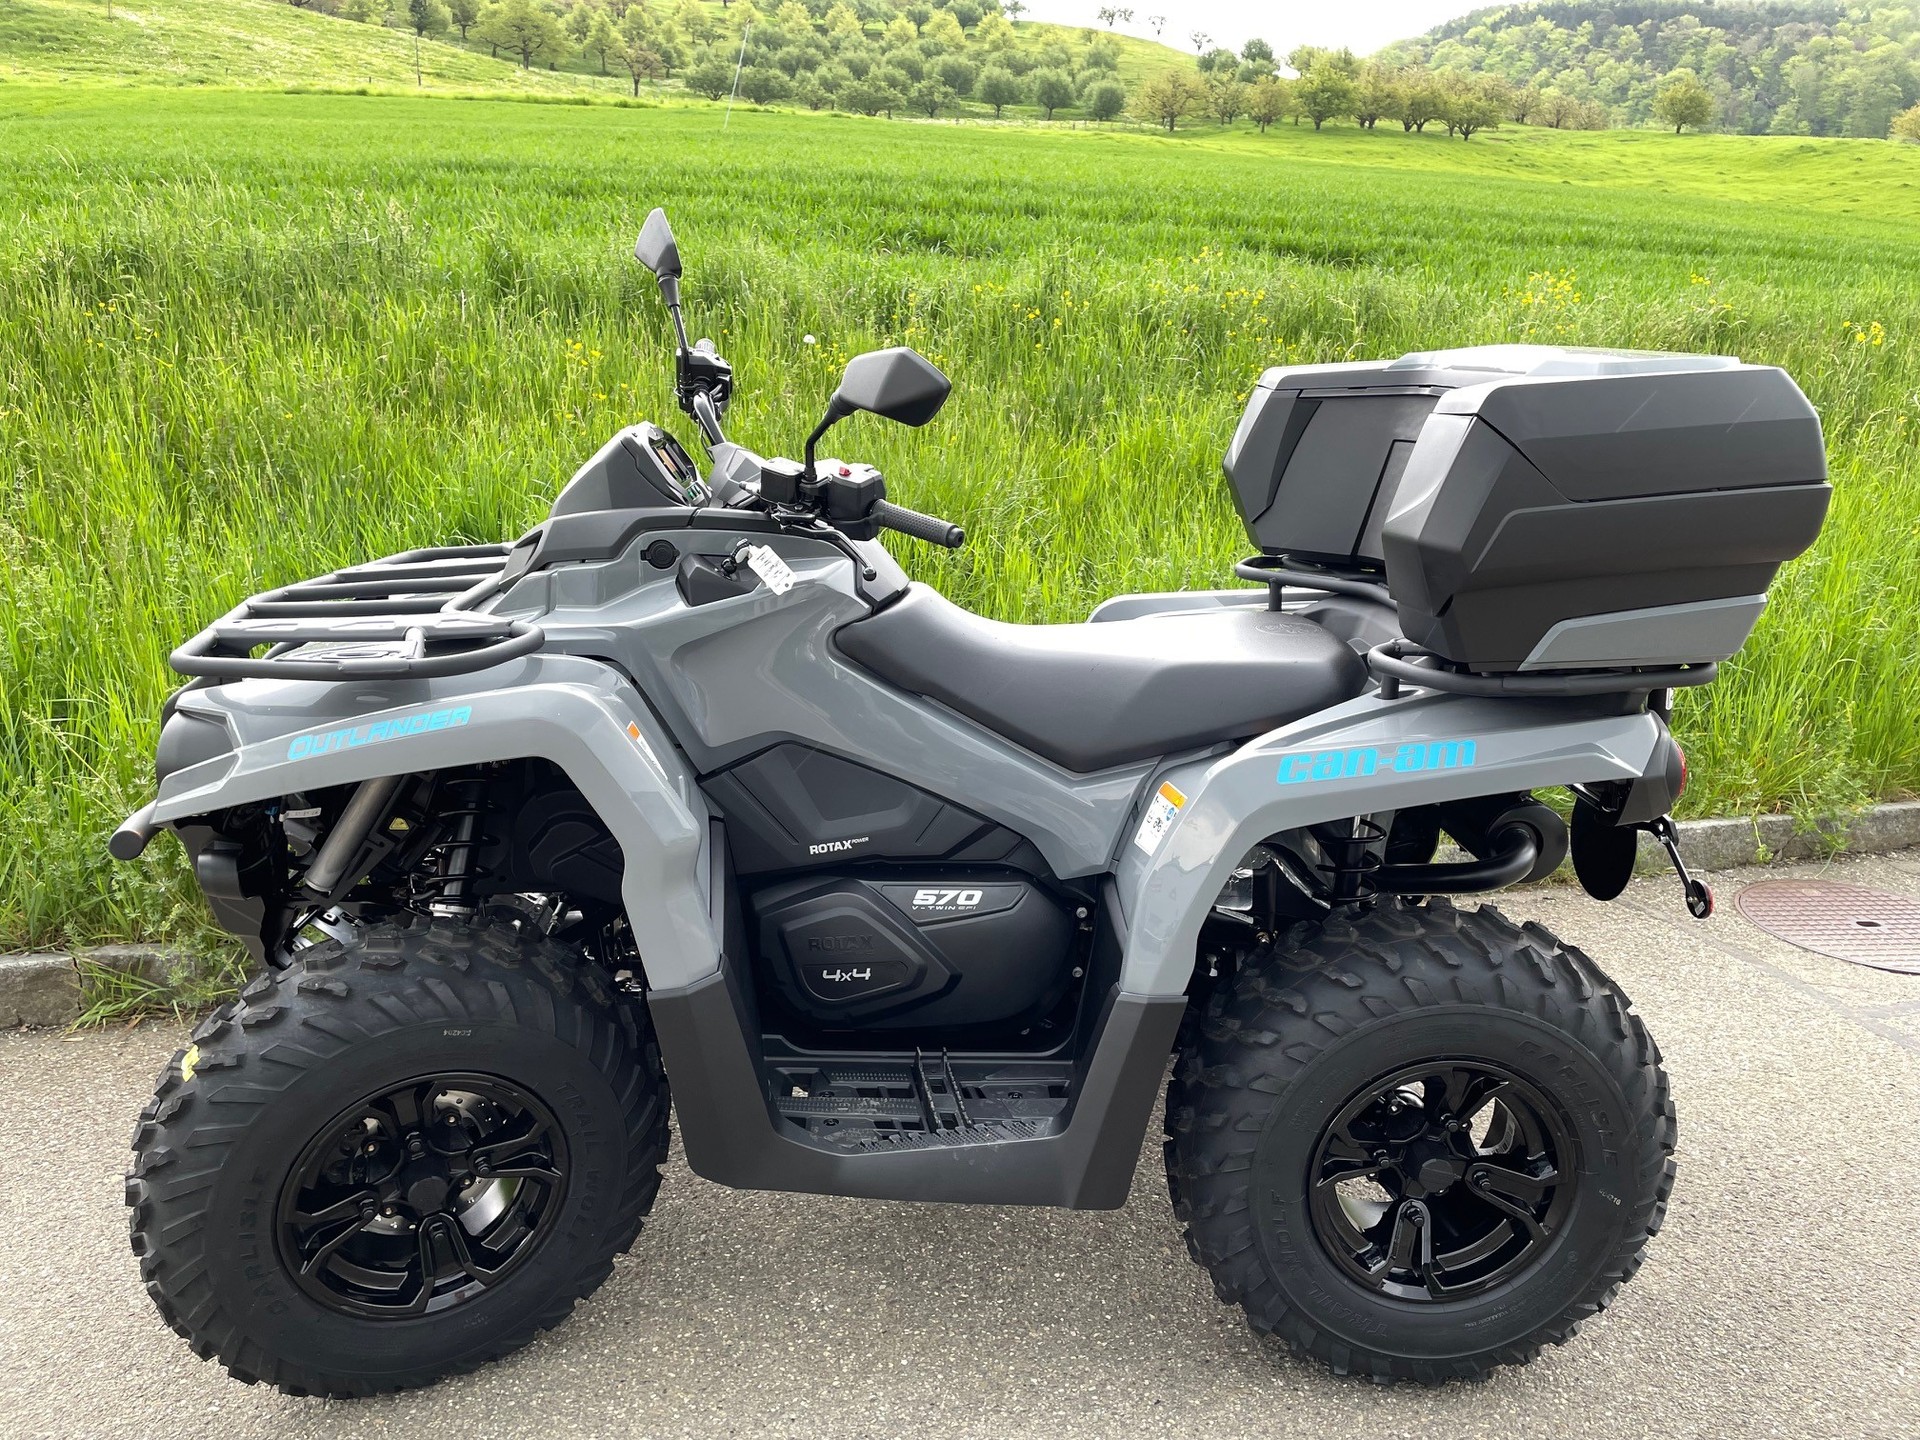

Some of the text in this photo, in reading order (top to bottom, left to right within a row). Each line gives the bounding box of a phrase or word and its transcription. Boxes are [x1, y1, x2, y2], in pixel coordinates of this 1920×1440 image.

[288, 705, 473, 760] OUTLANDER
[809, 840, 852, 855] ROTAX
[912, 889, 983, 906] 570
[808, 935, 873, 951] ROTAX
[822, 967, 871, 982] 4x4
[1308, 1280, 1388, 1338] TRAIL
